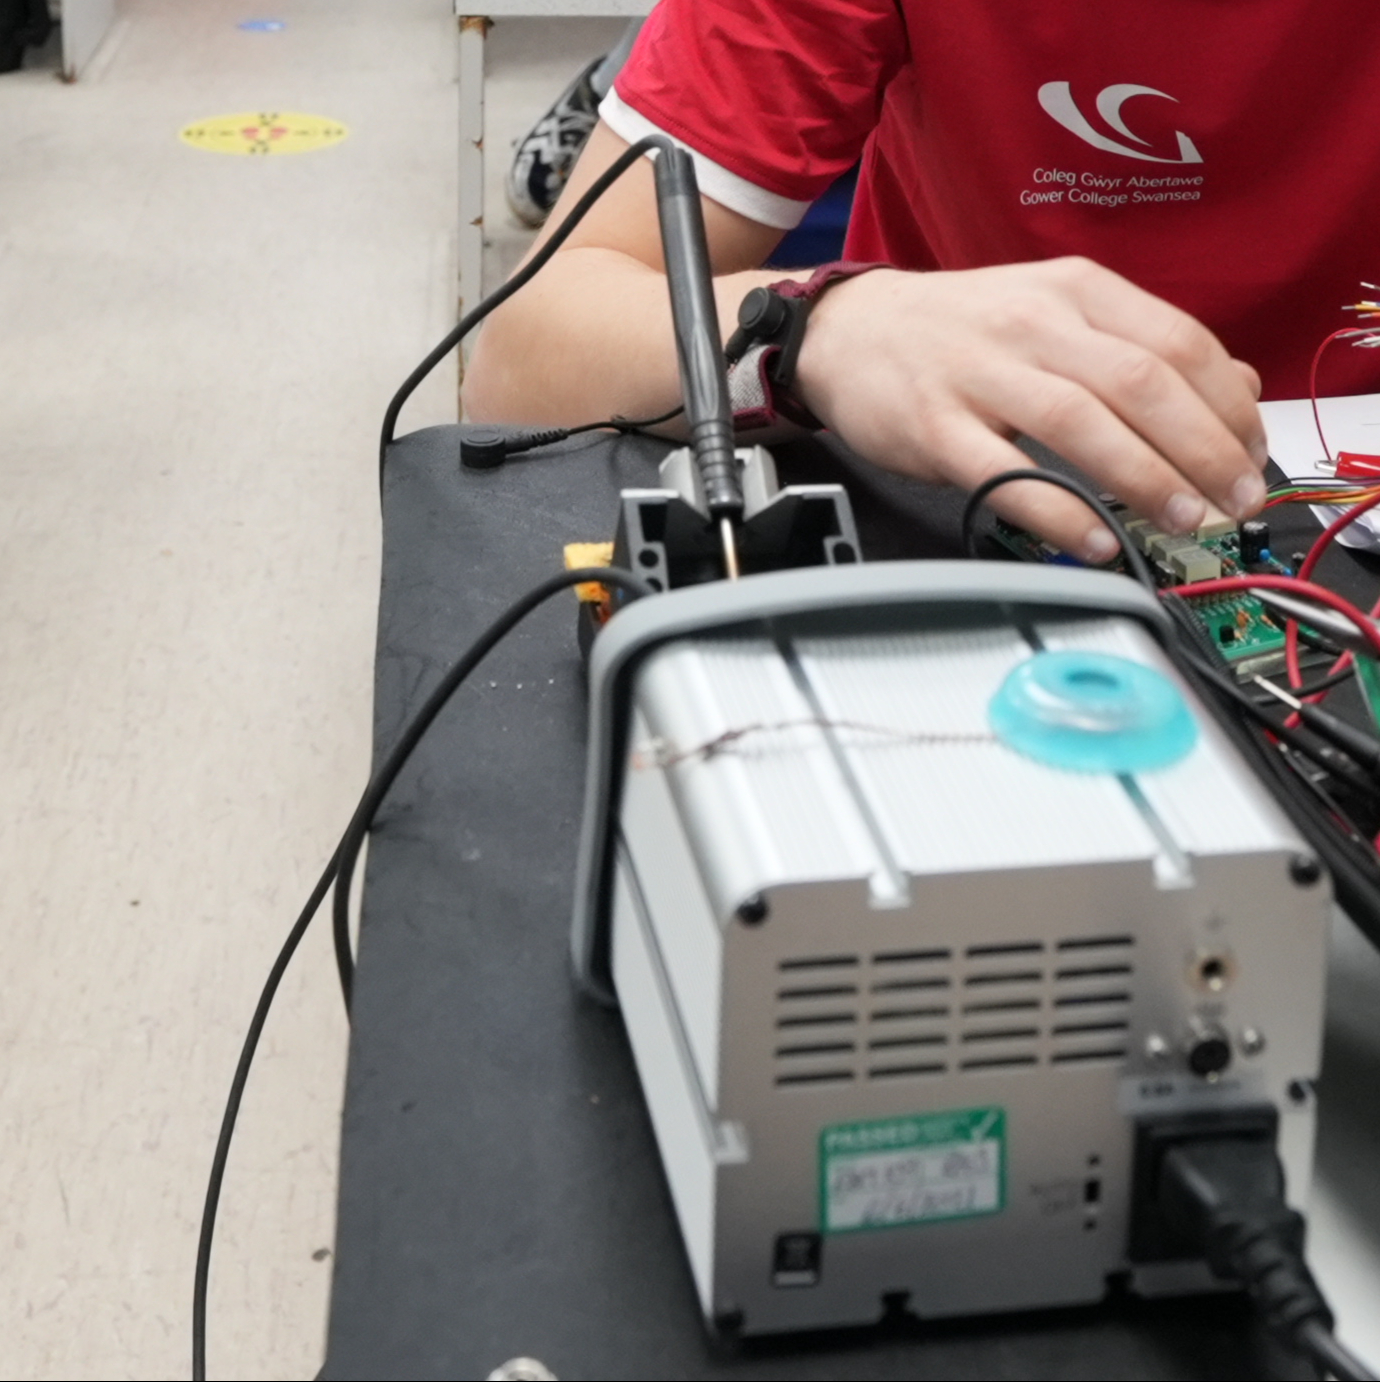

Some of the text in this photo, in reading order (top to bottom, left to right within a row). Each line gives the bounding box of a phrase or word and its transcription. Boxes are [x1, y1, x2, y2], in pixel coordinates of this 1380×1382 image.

[1032, 168, 1077, 186] Coleg
[1125, 175, 1205, 189] Abertawe
[1019, 188, 1202, 208] Gower College Swansea
